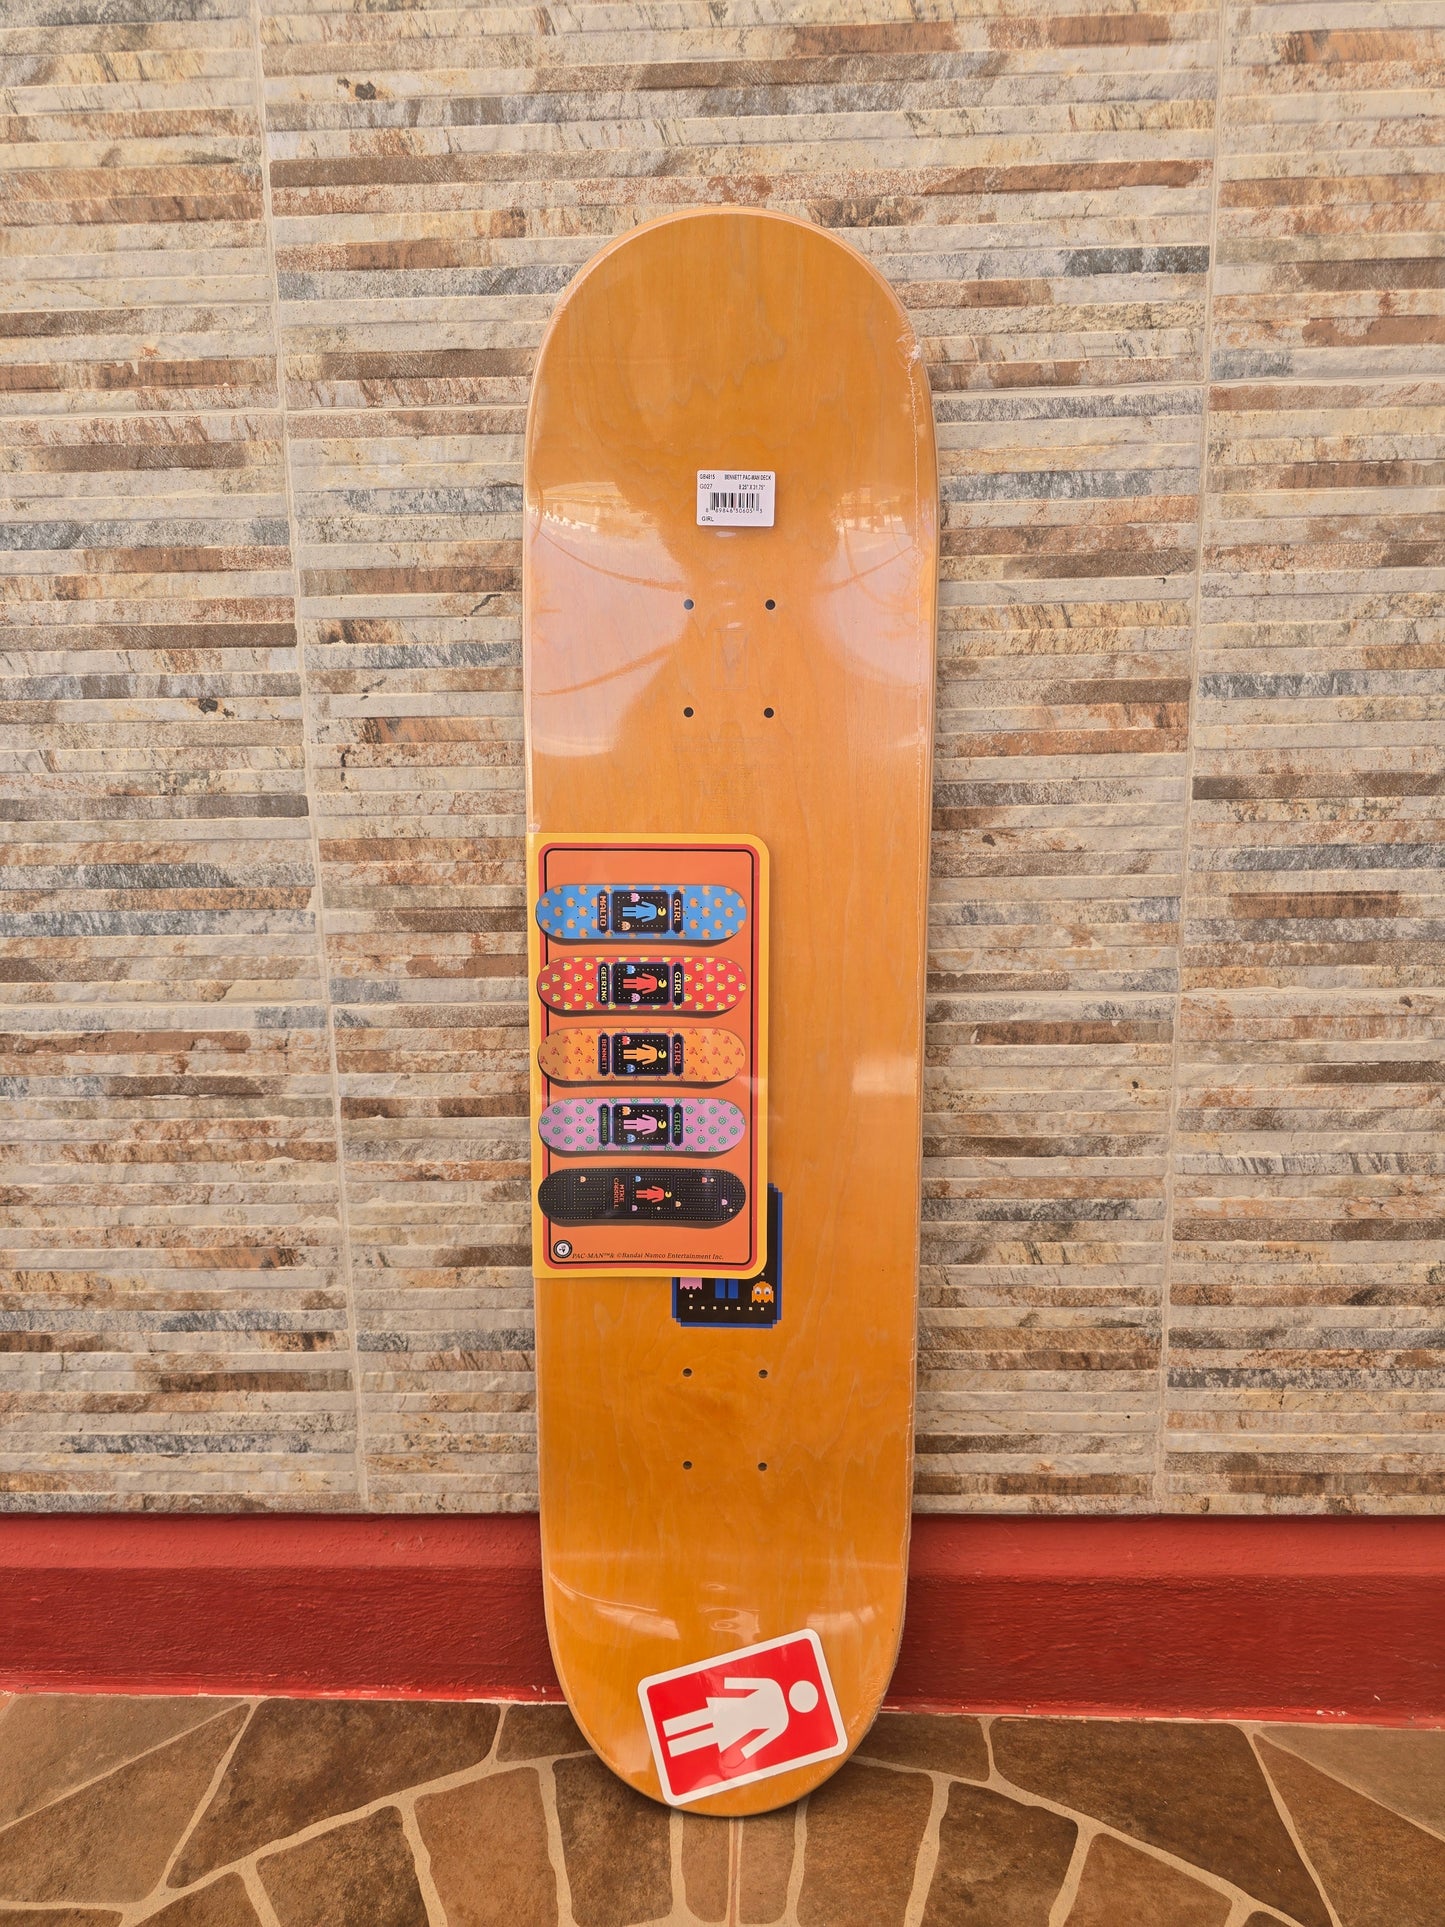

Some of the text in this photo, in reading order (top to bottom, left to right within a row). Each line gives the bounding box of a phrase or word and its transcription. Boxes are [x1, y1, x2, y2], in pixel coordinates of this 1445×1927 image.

[599, 895, 607, 927] MALTO
[673, 898, 681, 924] GIRL
[600, 966, 608, 1001] GEERING
[674, 971, 682, 996] GIRL
[667, 1252, 711, 1260] Entertainment
